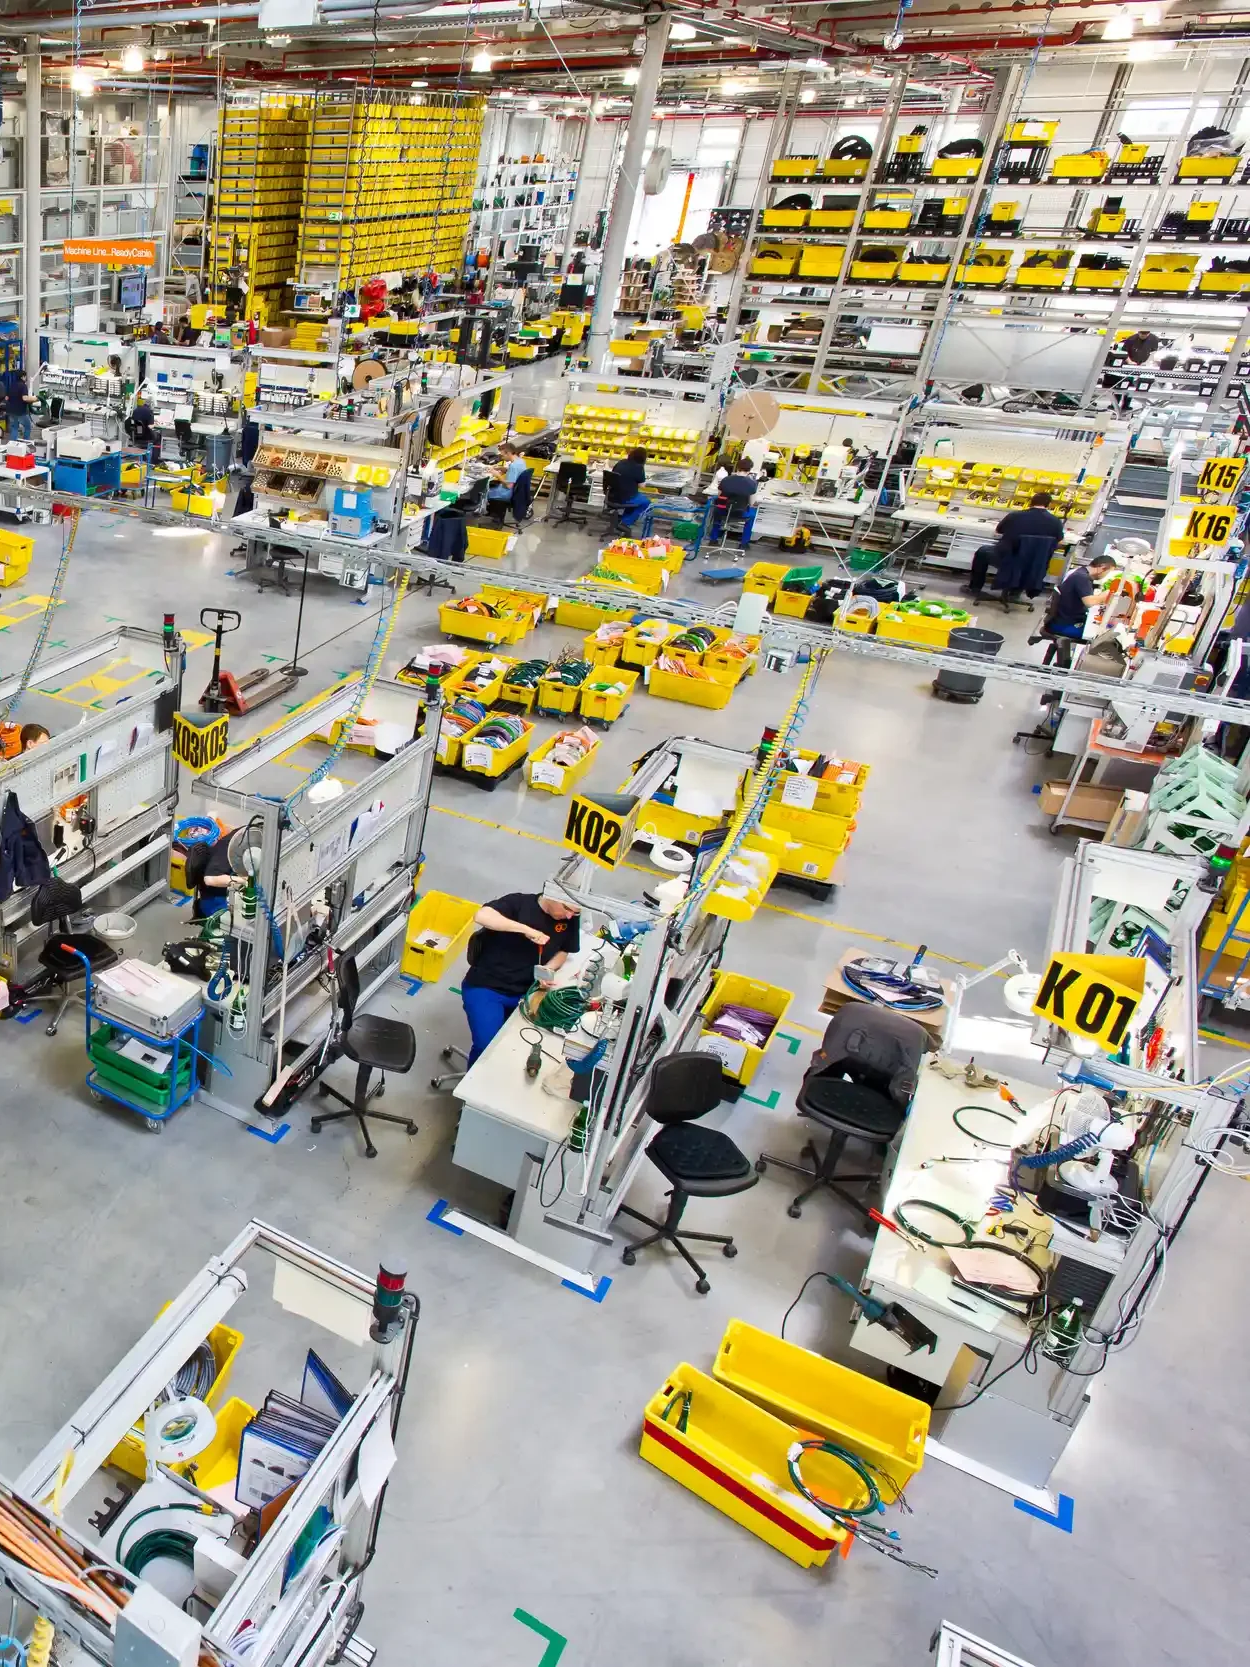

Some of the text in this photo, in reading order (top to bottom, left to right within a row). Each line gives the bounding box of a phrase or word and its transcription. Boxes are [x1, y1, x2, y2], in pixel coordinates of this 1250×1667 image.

[1200, 462, 1239, 488] K15
[1186, 511, 1230, 541] K16
[172, 718, 200, 768] K03
[200, 720, 229, 768] K03
[565, 799, 621, 866] K02
